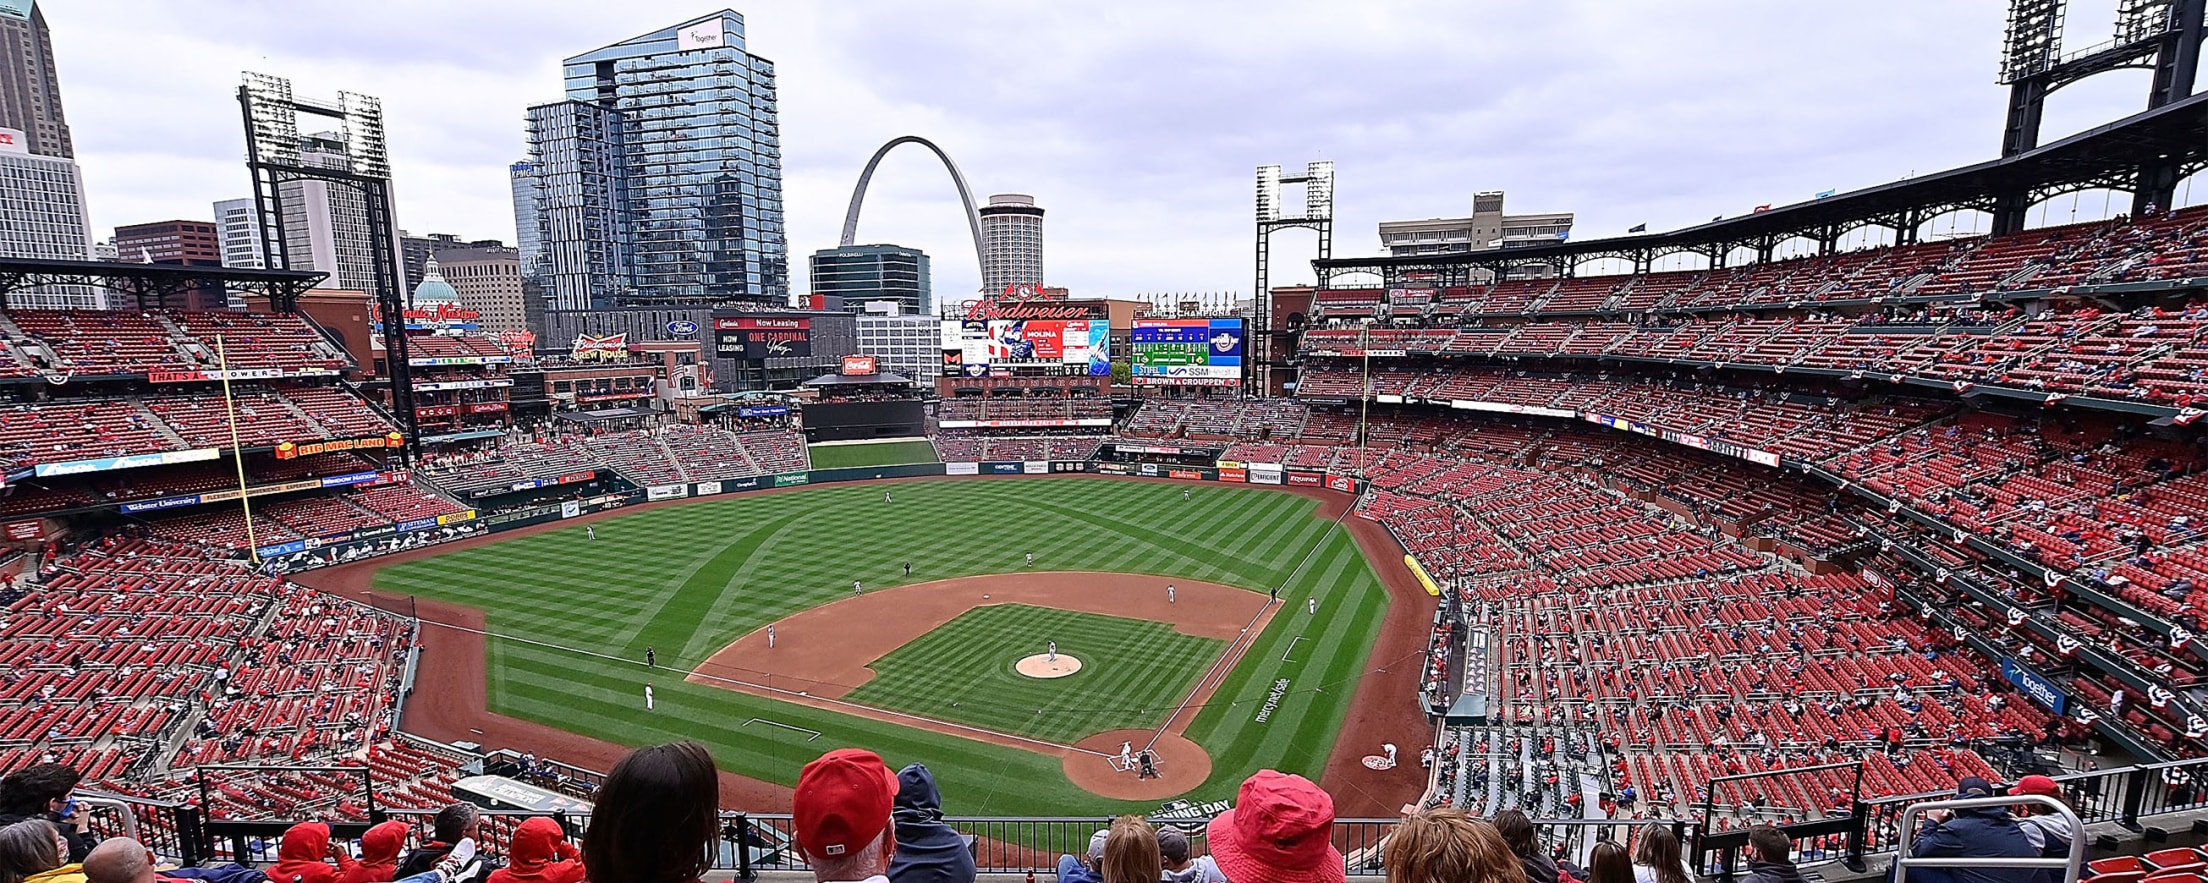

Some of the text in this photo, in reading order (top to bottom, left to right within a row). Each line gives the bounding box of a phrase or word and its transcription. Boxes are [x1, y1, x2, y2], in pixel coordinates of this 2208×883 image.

[511, 169, 532, 178] KPMG
[431, 303, 479, 323] Nation
[961, 299, 1089, 321] Budweiser
[673, 321, 693, 333] Ford
[756, 319, 771, 327] Now
[772, 319, 799, 329] Leasing
[722, 335, 738, 343] NOW
[748, 332, 808, 342] ONE CARDINAL
[717, 344, 744, 352] LEASING
[573, 350, 628, 362] BREW HOUSE
[152, 372, 189, 381] THAT'S
[193, 372, 199, 380] A
[1182, 378, 1225, 386] CROUPPEN
[299, 438, 385, 456] BIG MAC LAND
[127, 497, 197, 511] Webster University
[2021, 671, 2057, 704] Together
[1255, 677, 1291, 724] mercy.net/safe
[1201, 799, 1231, 814] DAY
